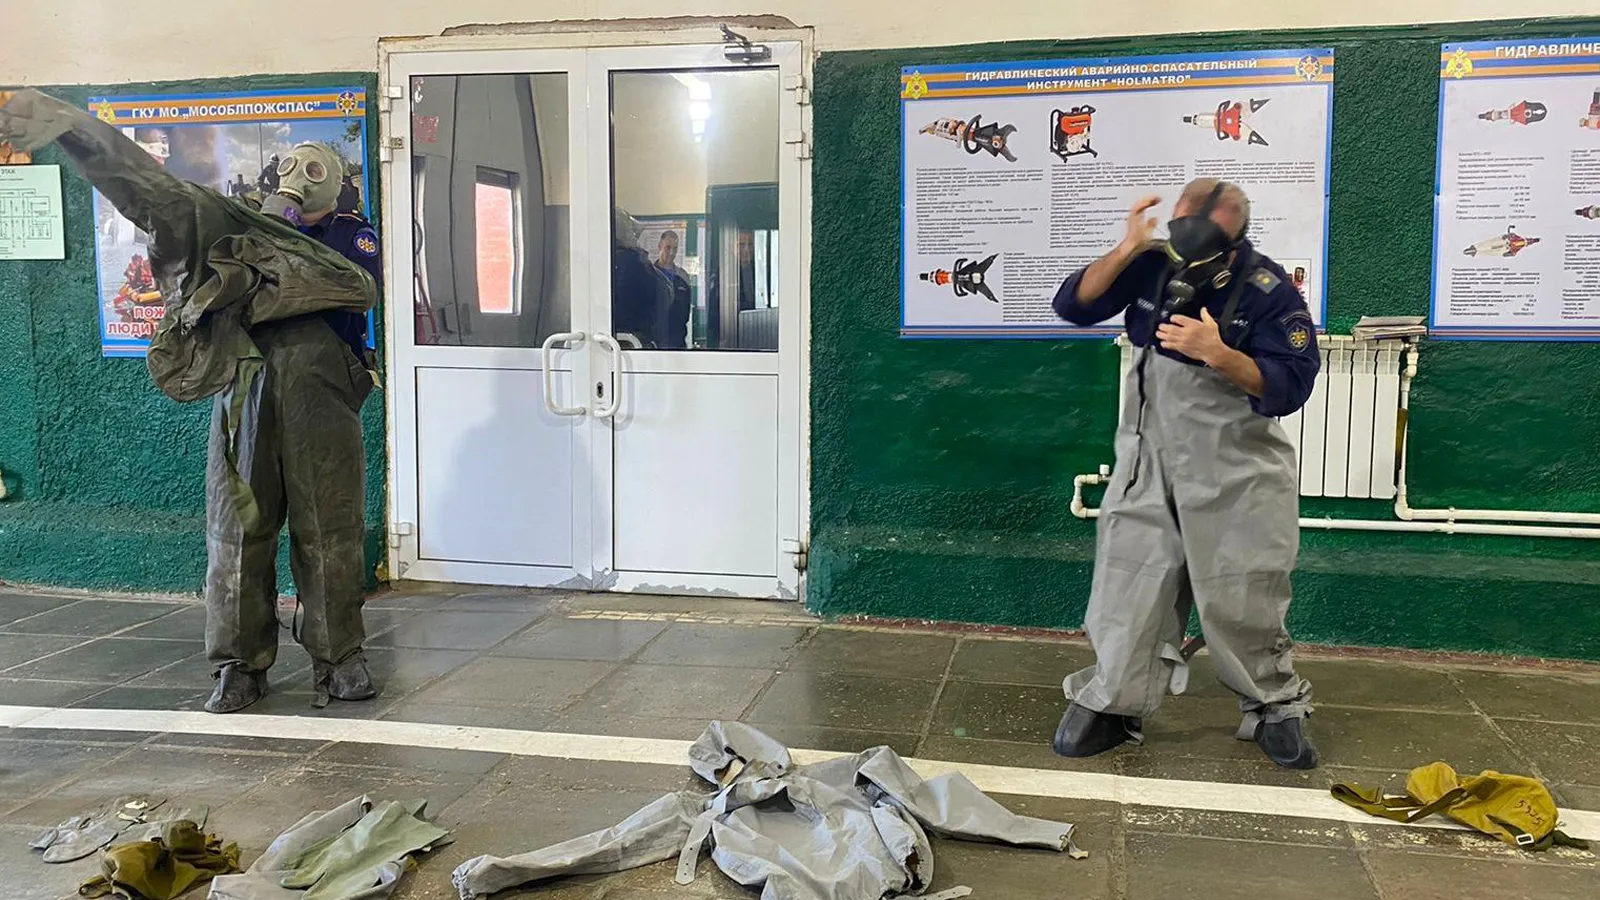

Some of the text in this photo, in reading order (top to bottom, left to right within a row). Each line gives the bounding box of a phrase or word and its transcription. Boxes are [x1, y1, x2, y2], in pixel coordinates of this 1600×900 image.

[965, 58, 1258, 81] ГИДРАВЛИЧЕСКИЙ АВАРИЙНО-СПАСАТЕЛЬНЫЙ
[1027, 78, 1108, 90] ИНСТРУМЕНТ
[132, 107, 154, 119] ГКУ
[159, 106, 179, 118] МО
[107, 323, 151, 337] ЛЮДИ
